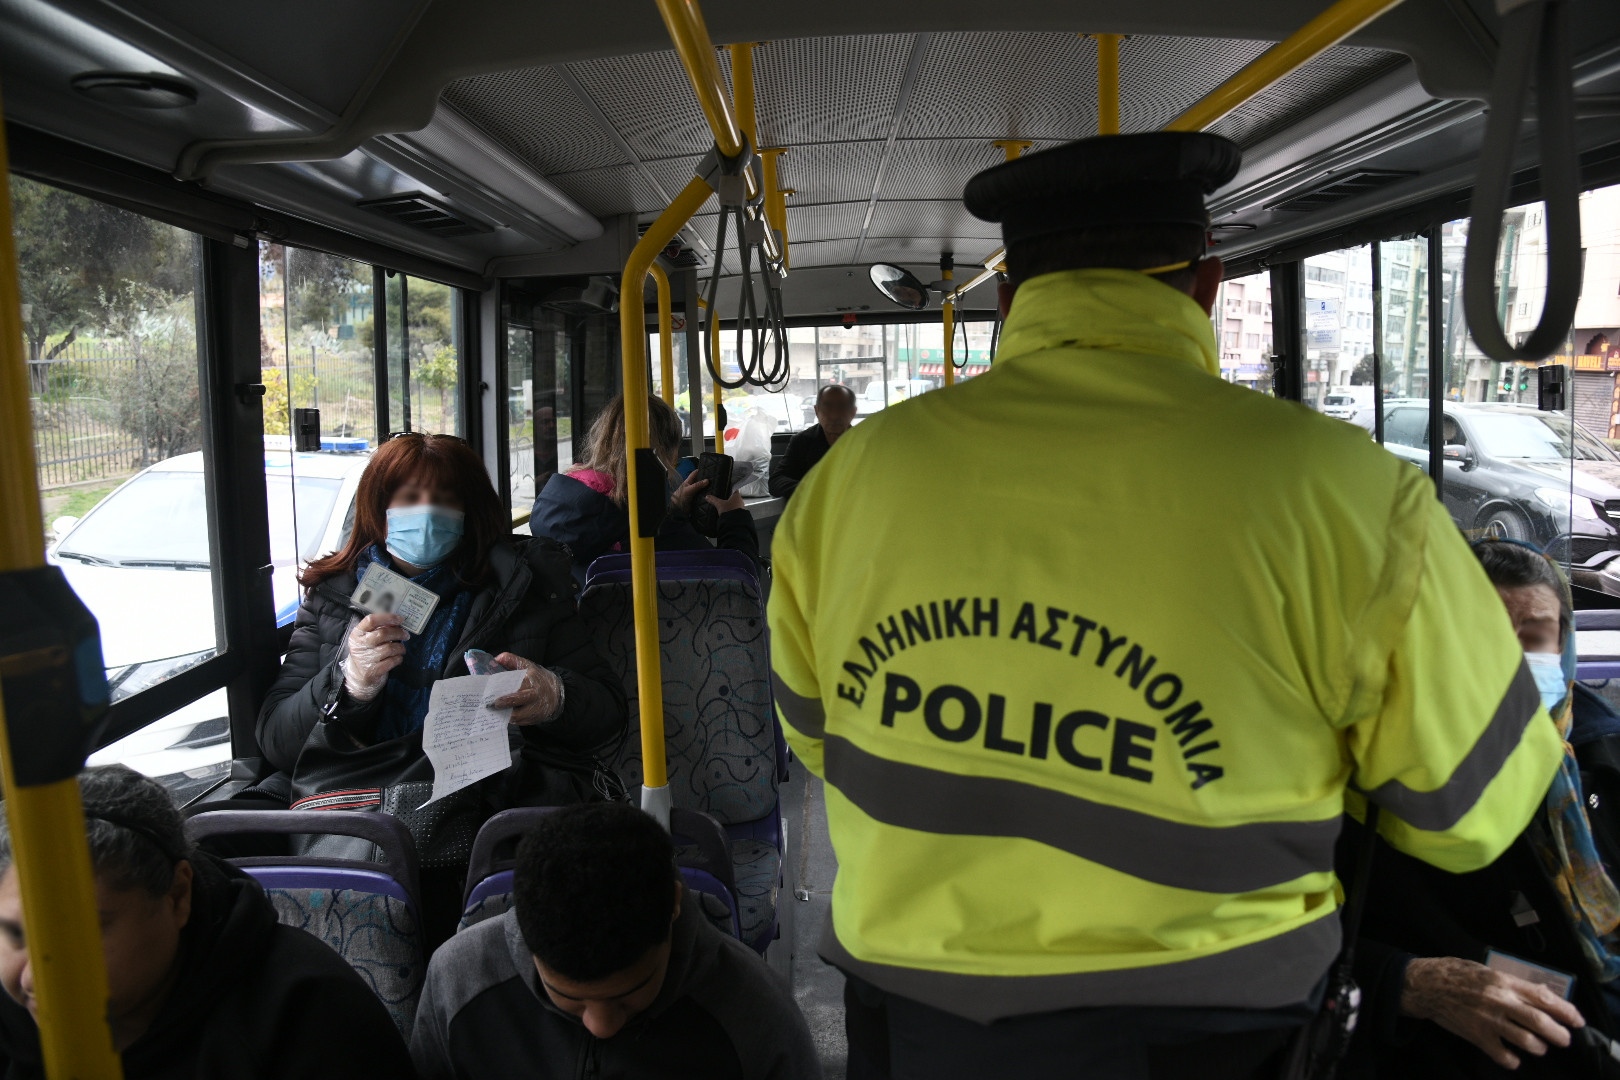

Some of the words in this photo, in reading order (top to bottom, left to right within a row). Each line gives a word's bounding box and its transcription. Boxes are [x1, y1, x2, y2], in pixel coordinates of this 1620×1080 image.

[837, 597, 999, 709] ΕΛΛΗΝΙΚΗ
[1010, 601, 1224, 790] ΑΣΤΥΝΟΜΙΑ
[880, 672, 1157, 784] POLICE
